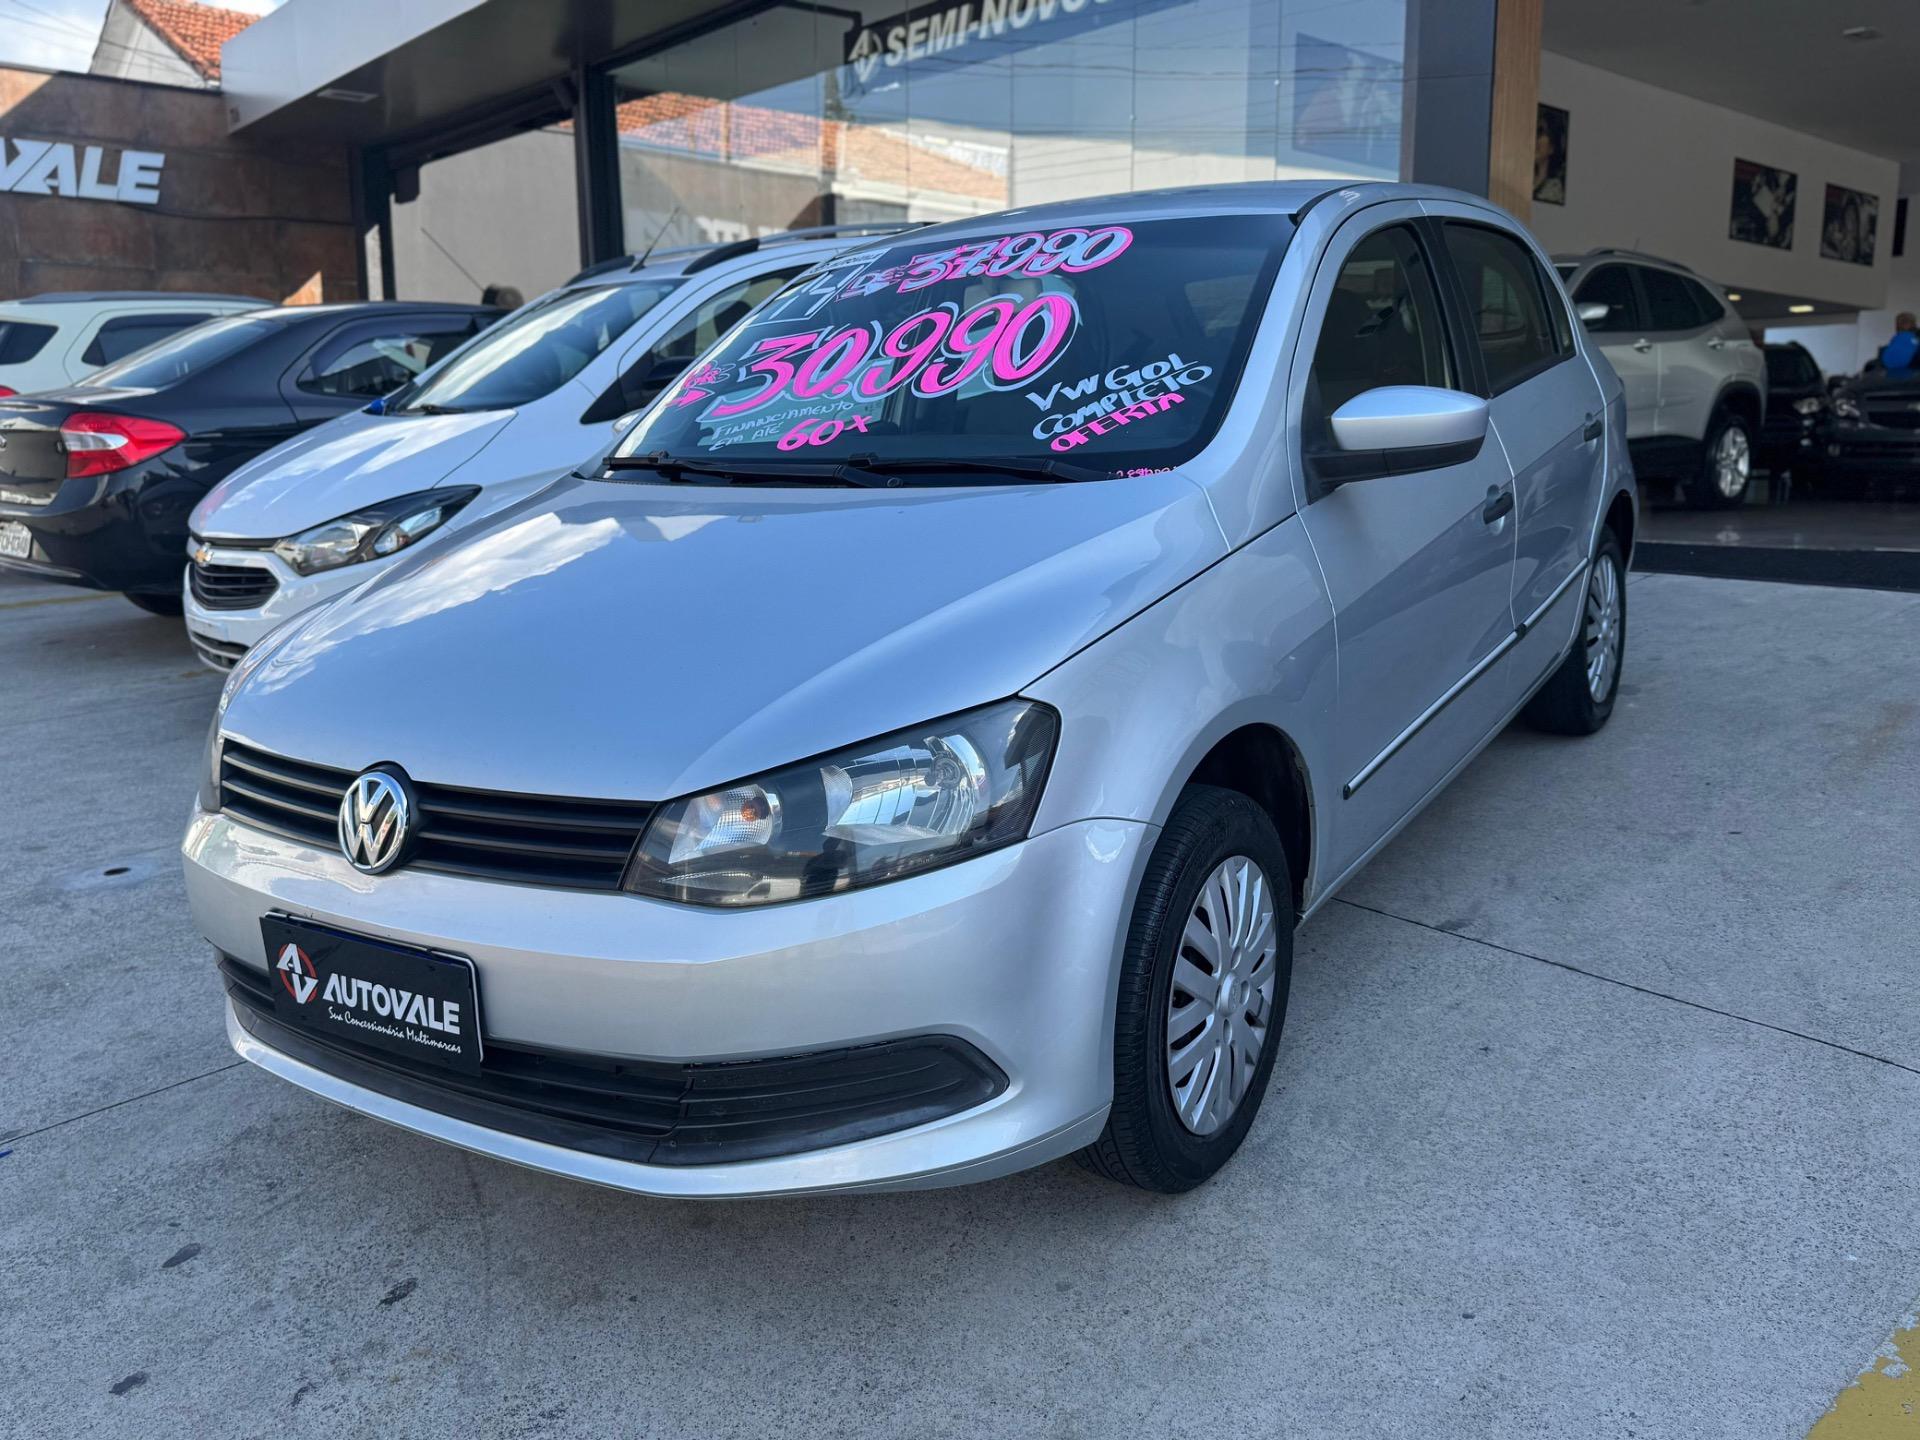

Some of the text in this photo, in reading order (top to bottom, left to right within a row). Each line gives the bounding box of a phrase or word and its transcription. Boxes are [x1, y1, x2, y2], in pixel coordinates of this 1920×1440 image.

[885, 0, 1115, 67] SEMI-NO
[0, 136, 166, 205] VALE
[696, 291, 1083, 423] 30.990
[1104, 352, 1199, 391] GOL
[711, 400, 854, 441] FINANCIAMENTO
[1032, 365, 1214, 441] COMPLETO
[1050, 392, 1186, 452] OFERTA
[322, 972, 461, 1036] AUTOVALE
[328, 1005, 344, 1022] Sua
[406, 1026, 462, 1054] Multimarcas
